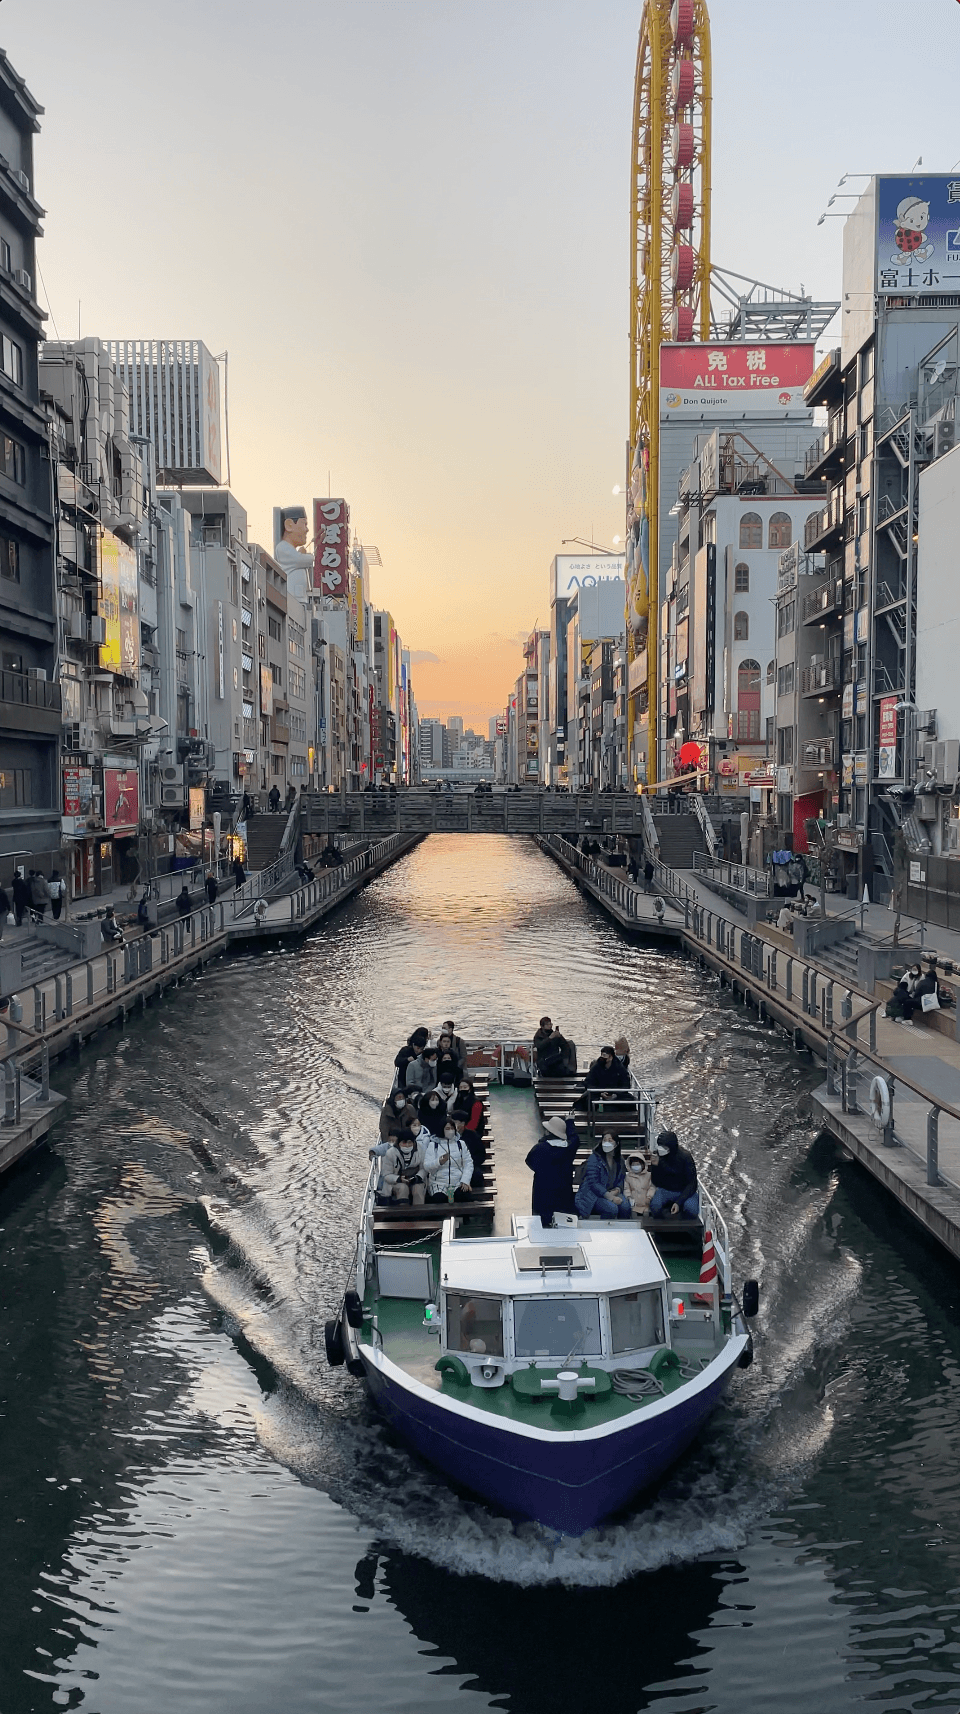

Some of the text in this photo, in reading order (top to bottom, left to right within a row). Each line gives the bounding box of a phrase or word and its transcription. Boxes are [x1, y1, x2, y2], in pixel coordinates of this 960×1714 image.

[694, 373, 780, 387] ALL Tax Free
[700, 397, 728, 406] Quijote
